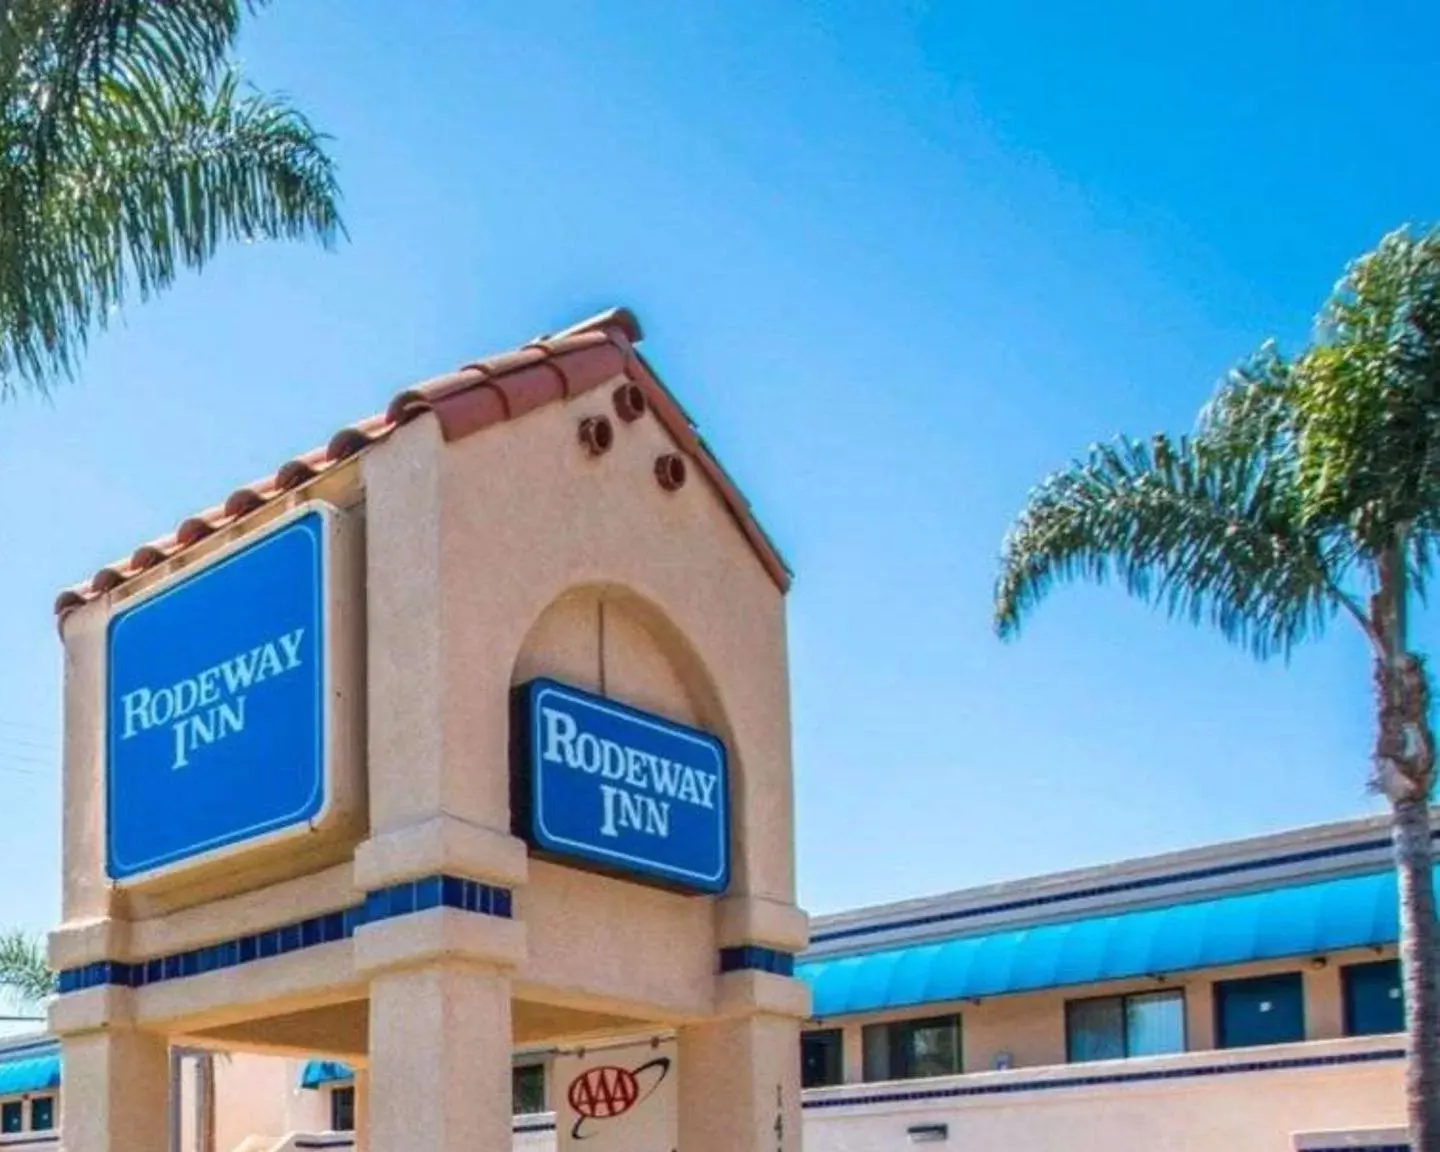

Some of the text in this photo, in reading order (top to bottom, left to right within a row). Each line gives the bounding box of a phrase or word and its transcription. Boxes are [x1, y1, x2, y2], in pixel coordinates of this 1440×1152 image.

[121, 628, 305, 740] RODEWAY
[171, 695, 246, 770] INN
[543, 708, 717, 809] RODEWAY
[600, 784, 670, 838] INN
[573, 1069, 631, 1112] AAA
